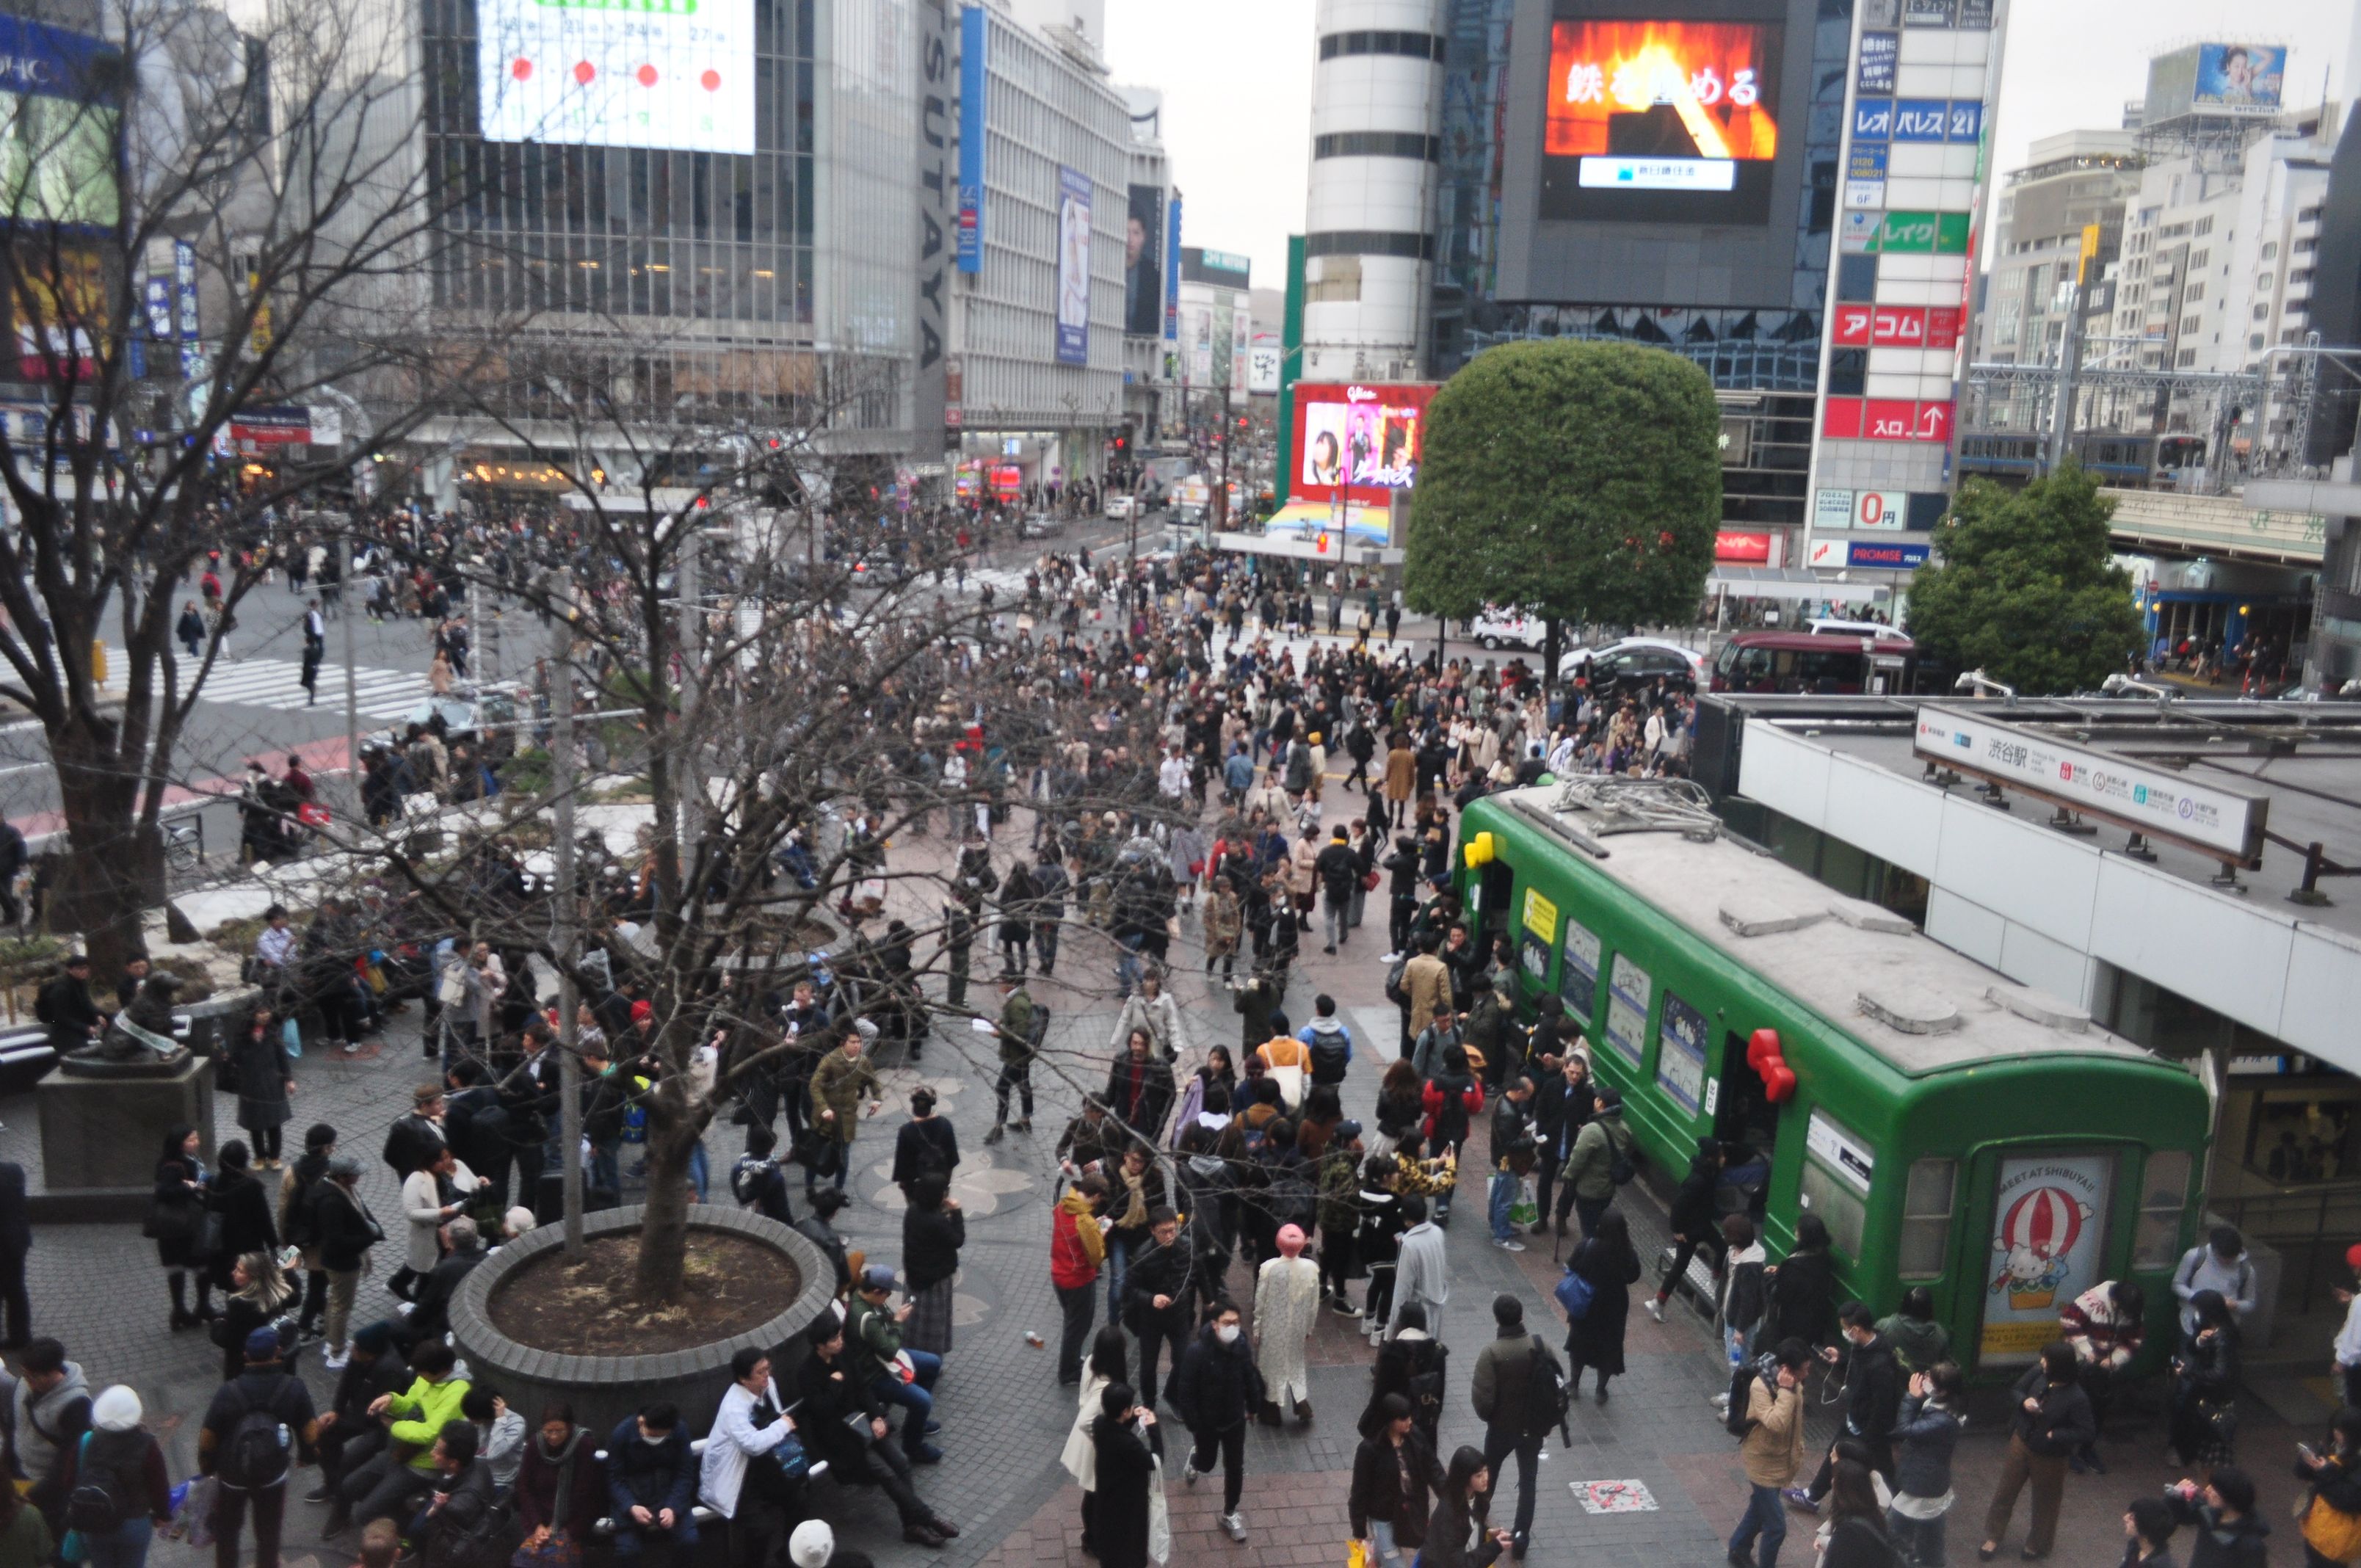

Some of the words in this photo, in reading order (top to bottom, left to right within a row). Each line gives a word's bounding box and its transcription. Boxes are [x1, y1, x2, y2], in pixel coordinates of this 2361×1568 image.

[1566, 64, 1757, 105] 鉄をめる
[1857, 195, 1871, 204] 6F
[1883, 222, 1934, 243] レイク
[1843, 314, 1921, 337] アコム
[1346, 386, 1378, 403] Glico
[1874, 420, 1903, 437] 入口
[1860, 492, 1896, 525] 0円
[1854, 548, 1901, 562] PROMISE
[1988, 738, 2028, 768] 渋谷駅
[2000, 1171, 2028, 1195] MEET
[2028, 1167, 2043, 1179] AT
